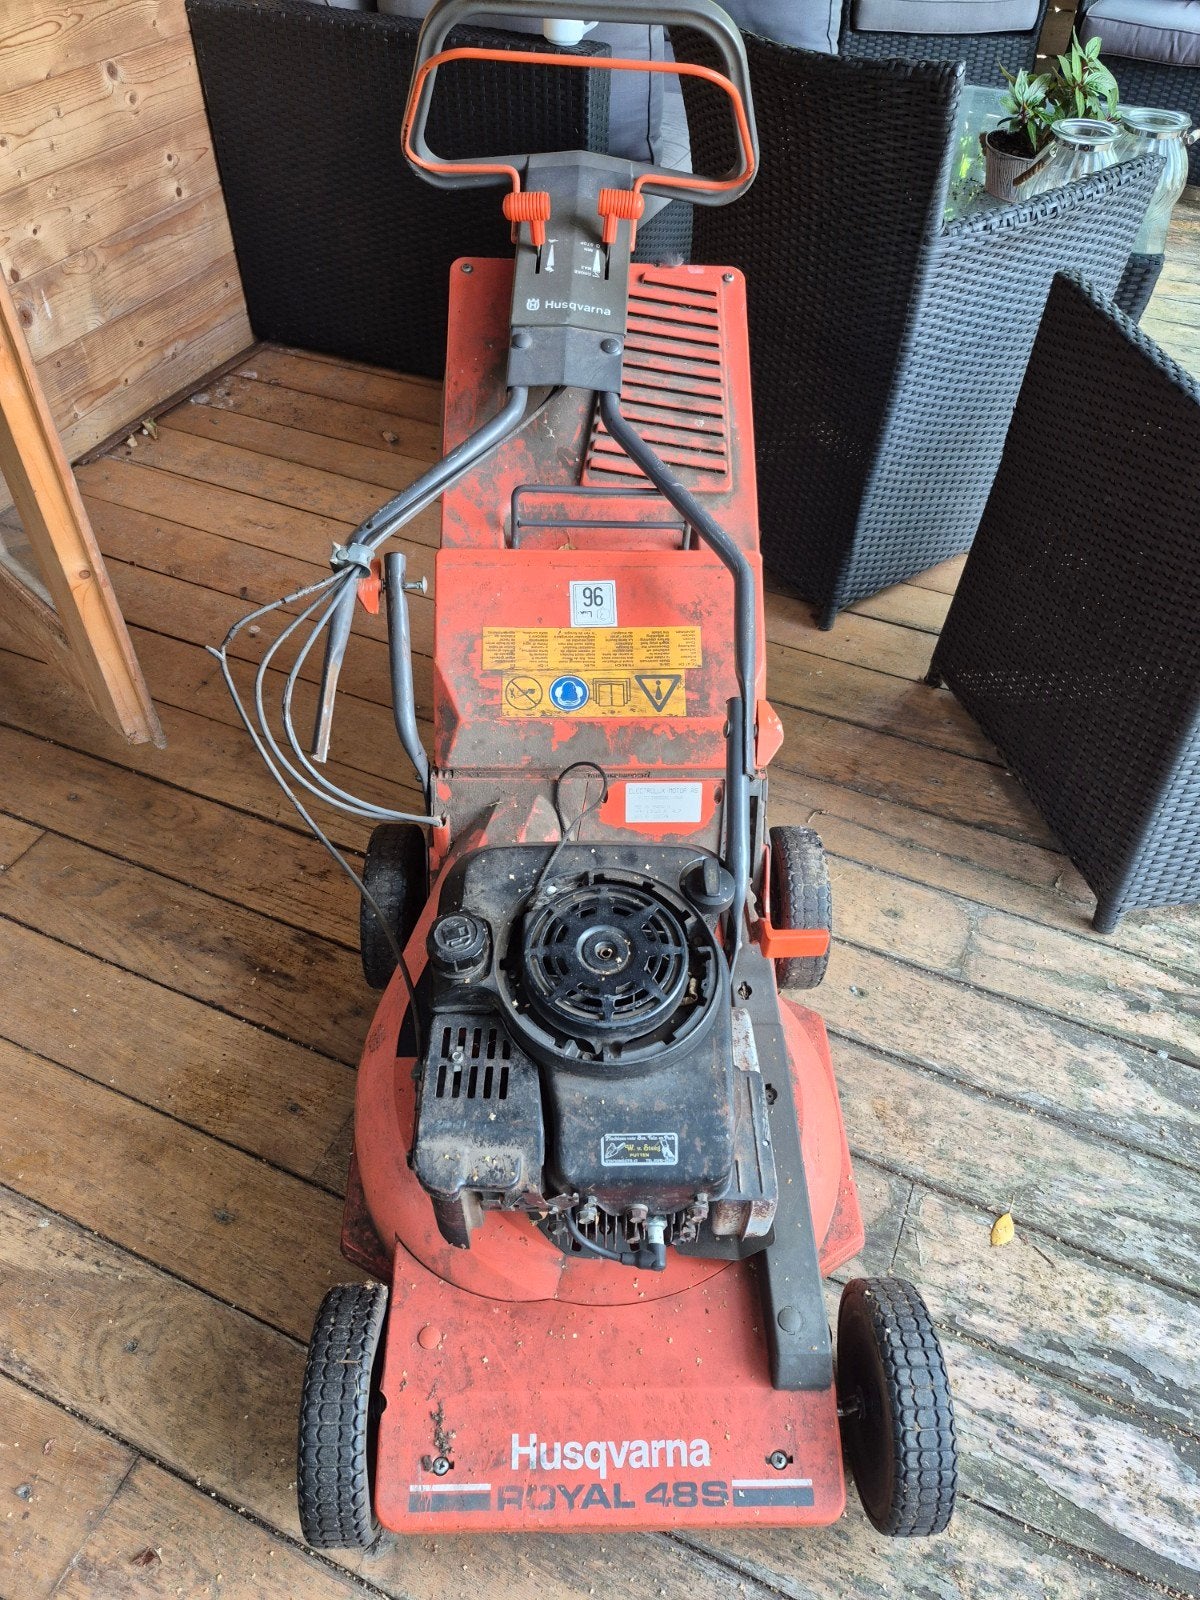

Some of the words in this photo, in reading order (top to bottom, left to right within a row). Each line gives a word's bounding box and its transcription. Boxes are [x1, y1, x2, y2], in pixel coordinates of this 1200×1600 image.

[545, 300, 612, 316] Husqvarna
[583, 587, 604, 607] 96
[511, 1433, 711, 1479] Husqvarna
[496, 1484, 636, 1512] ROYAL
[645, 1481, 730, 1508] 48S
